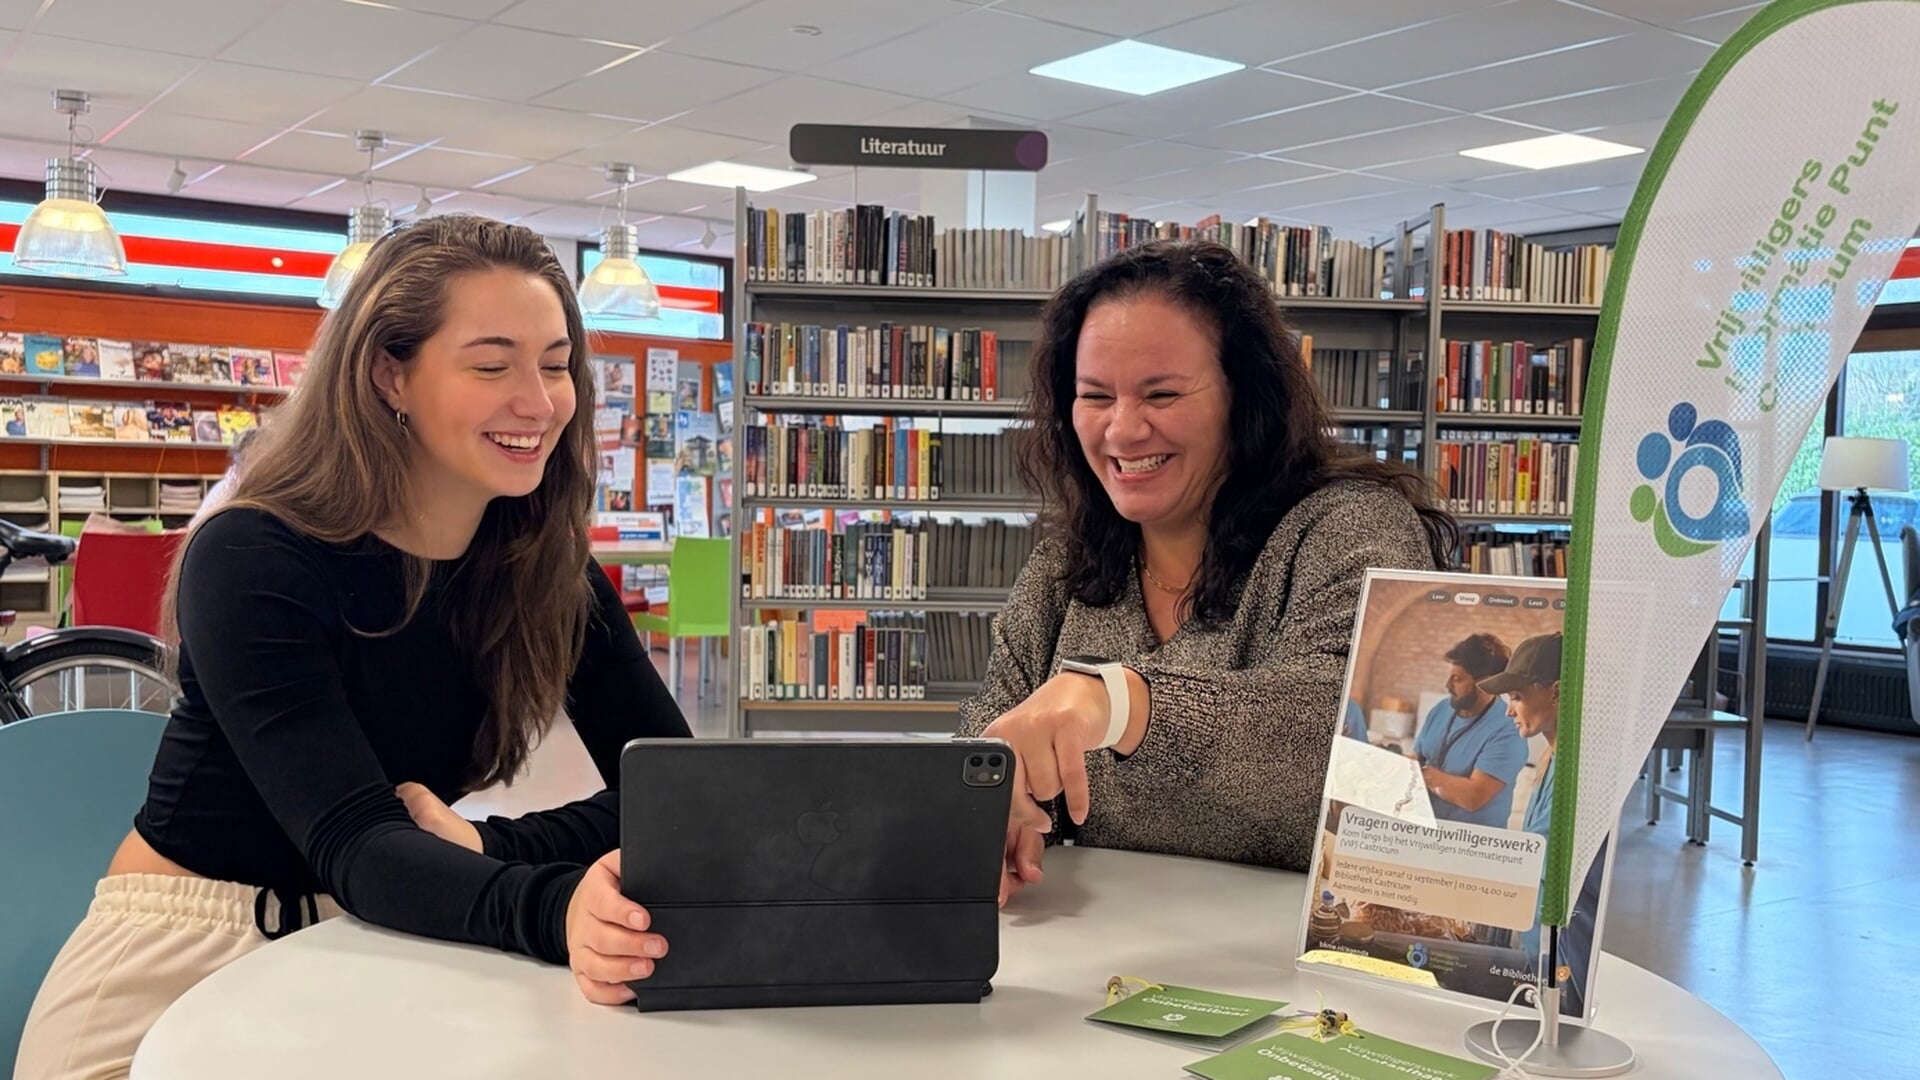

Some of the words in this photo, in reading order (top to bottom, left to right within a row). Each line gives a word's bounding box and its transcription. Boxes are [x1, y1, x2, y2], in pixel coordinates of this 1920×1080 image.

[861, 137, 946, 156] Literatuur
[1828, 98, 1899, 195] Punt
[1696, 159, 1822, 369] Vrijilligers
[1342, 828, 1360, 837] Kom
[1361, 830, 1382, 843] langs
[1383, 833, 1394, 845] bij
[1395, 835, 1408, 846] het
[1409, 838, 1457, 854] Vrijwilligers
[1345, 812, 1389, 831] Vragen
[1391, 821, 1421, 834] over
[1422, 825, 1541, 854] vrijwilligerswerk?
[1340, 838, 1358, 848] (VIP)
[1360, 841, 1399, 855] Castricum
[1334, 870, 1373, 884] Bibliotheek
[1375, 877, 1412, 890] Castricum
[1359, 865, 1383, 876] vrijdag
[1384, 870, 1405, 879] vanaf
[1414, 875, 1453, 888] september
[1333, 881, 1372, 894] Aanmelden
[1381, 890, 1396, 900] niet
[1396, 894, 1418, 905] nodig
[1490, 965, 1501, 975] de
[1142, 997, 1249, 1016] Onbetaalbaar
